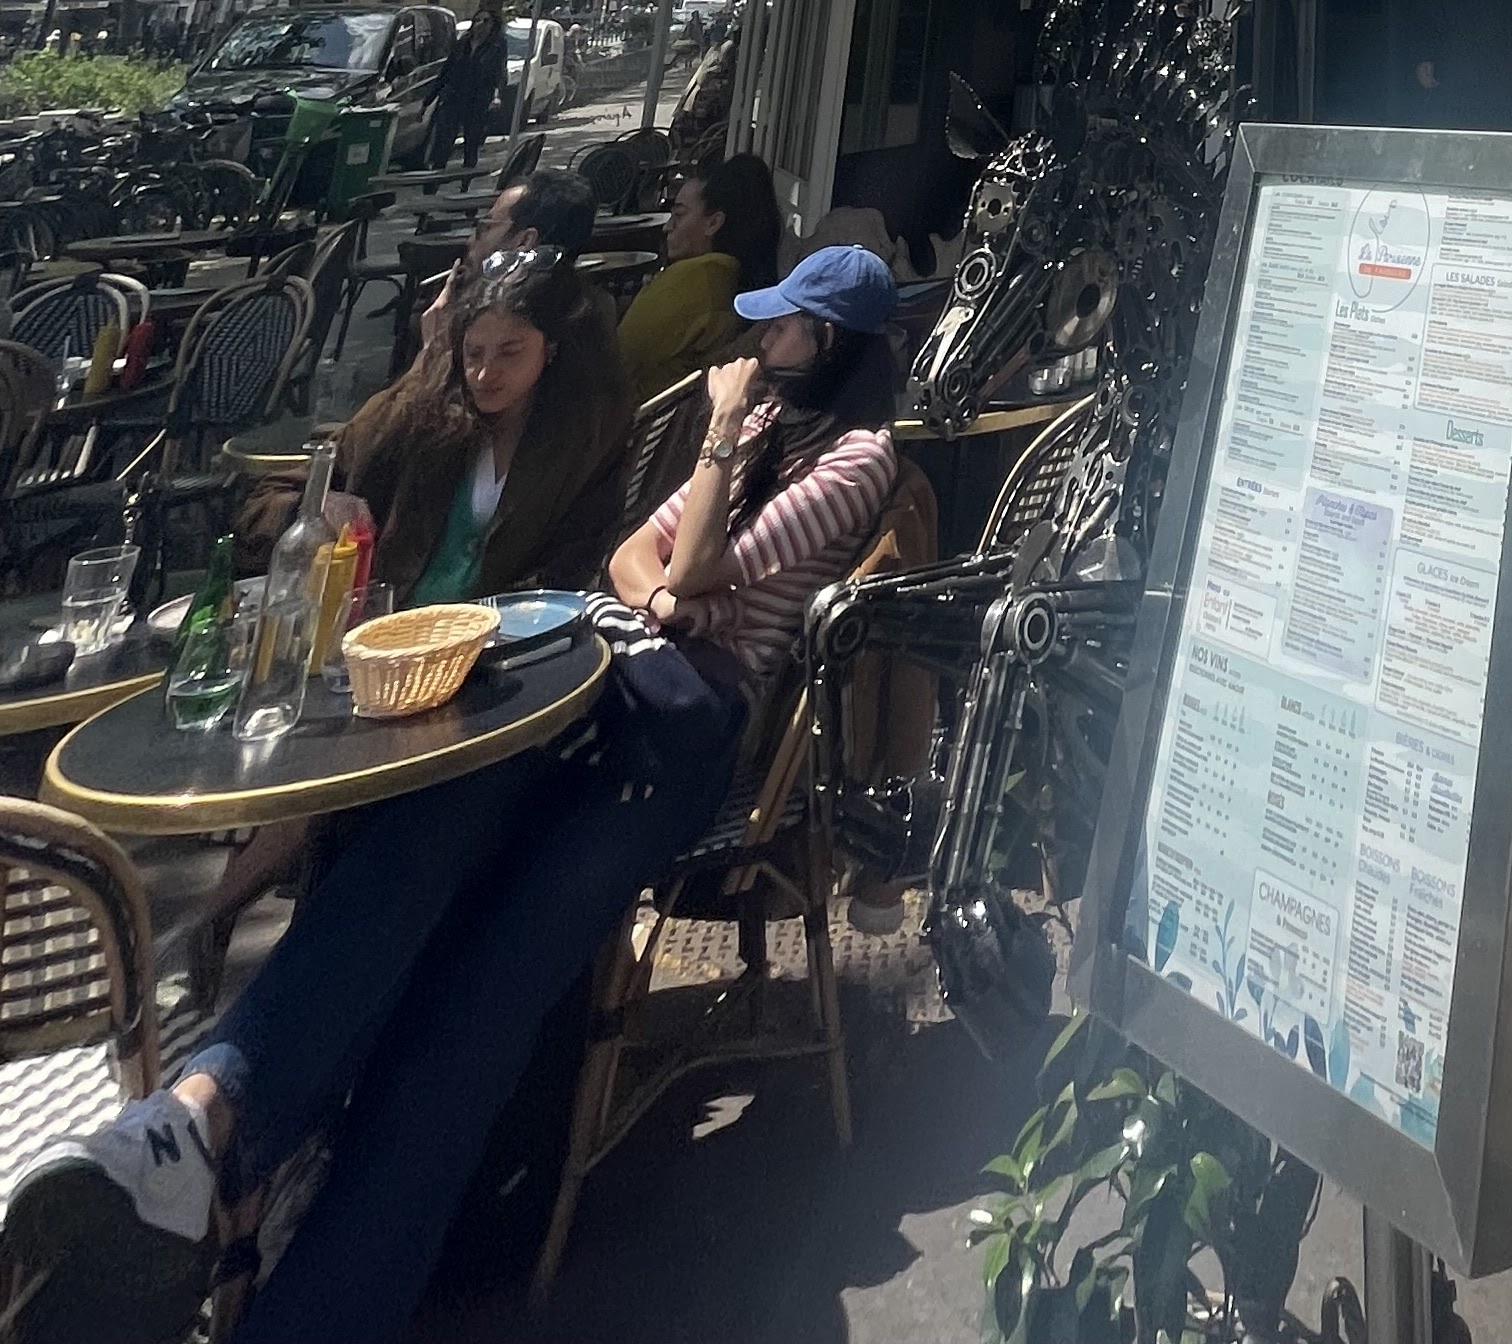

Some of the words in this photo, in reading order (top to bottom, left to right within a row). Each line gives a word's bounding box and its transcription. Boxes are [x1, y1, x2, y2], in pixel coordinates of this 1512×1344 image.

[1460, 273, 1496, 287] SALADES
[1335, 299, 1348, 319] Les
[1446, 419, 1485, 447] Desserts
[1417, 562, 1449, 582] GLACES
[1191, 644, 1209, 665] NOS
[1210, 651, 1229, 674] VINS
[1258, 881, 1332, 937] CHAMPAGNES
